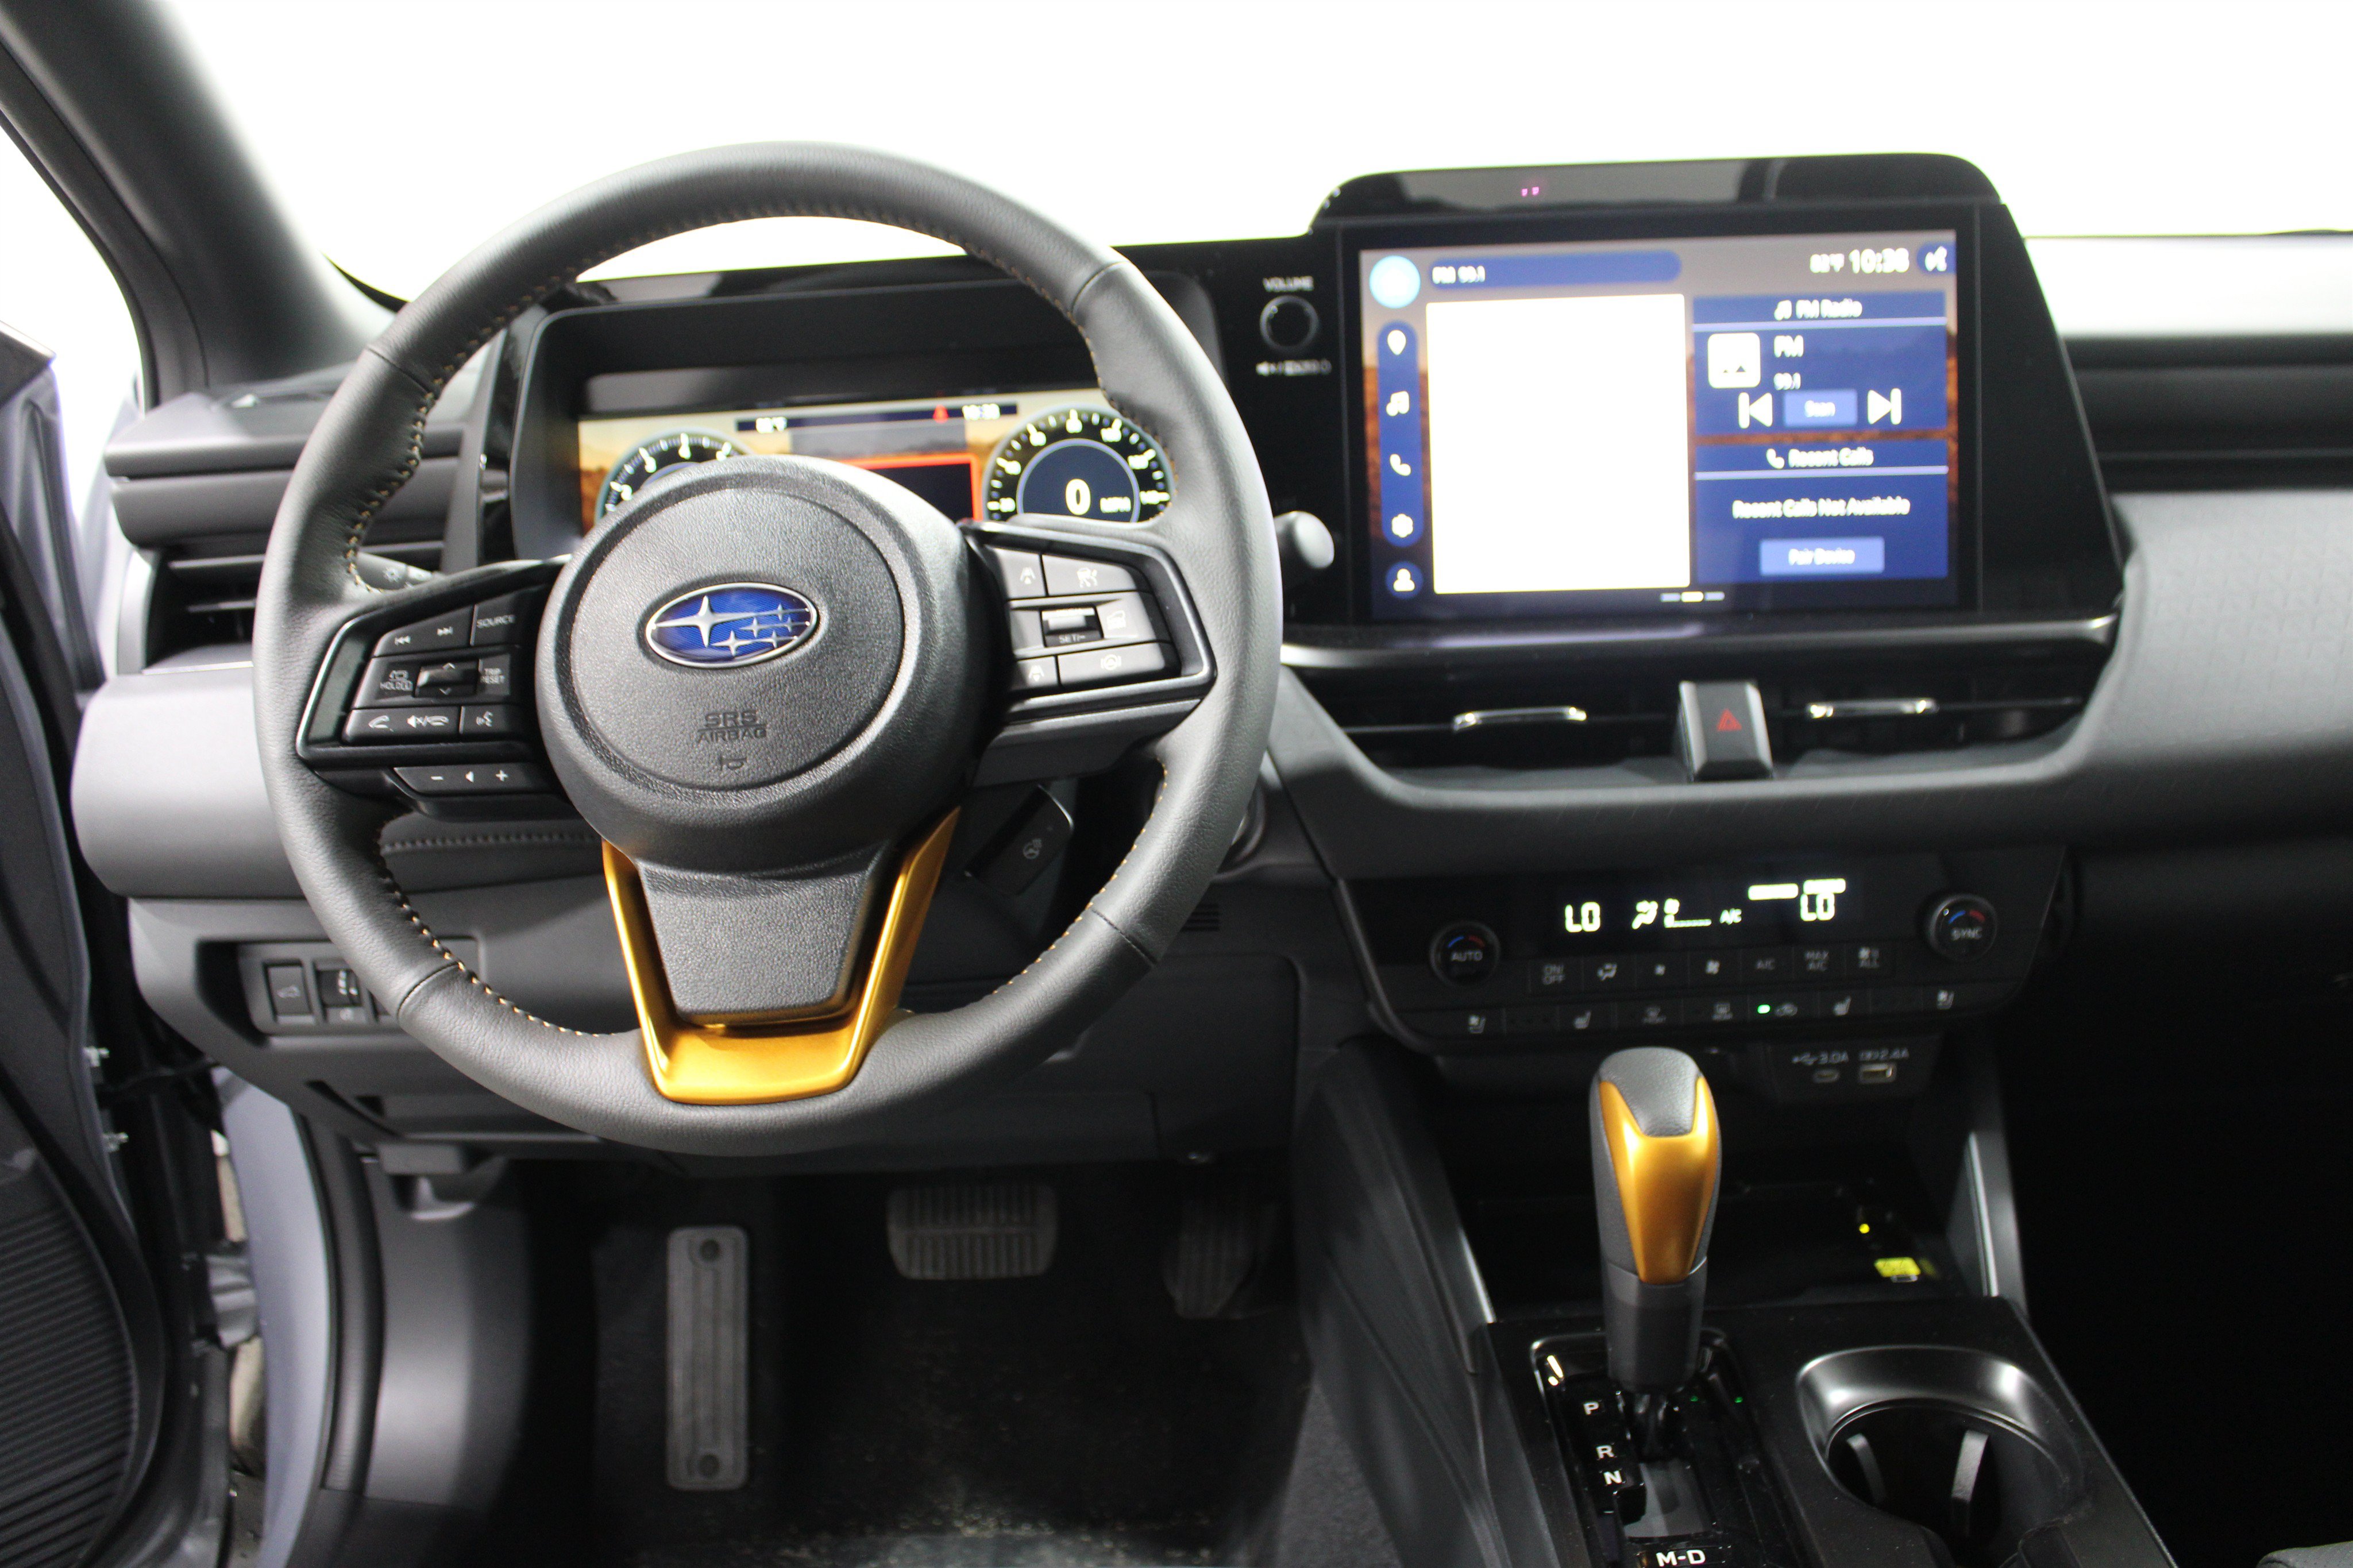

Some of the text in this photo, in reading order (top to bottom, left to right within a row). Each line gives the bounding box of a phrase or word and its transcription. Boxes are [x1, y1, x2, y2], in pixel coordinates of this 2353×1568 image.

[1263, 276, 1314, 292] VOLUME
[1774, 335, 1804, 357] FM
[1065, 478, 1091, 516] 0
[477, 615, 515, 628] SOURCE
[484, 667, 502, 675] TRIP
[704, 709, 757, 727] SRS
[696, 727, 767, 743] AIRBAG
[1565, 901, 1601, 933] LO
[1951, 927, 1983, 941] SYNC
[1451, 950, 1483, 962] AUTO
[1584, 1401, 1599, 1415] P
[1596, 1445, 1614, 1459] R
[1603, 1470, 1622, 1485] N
